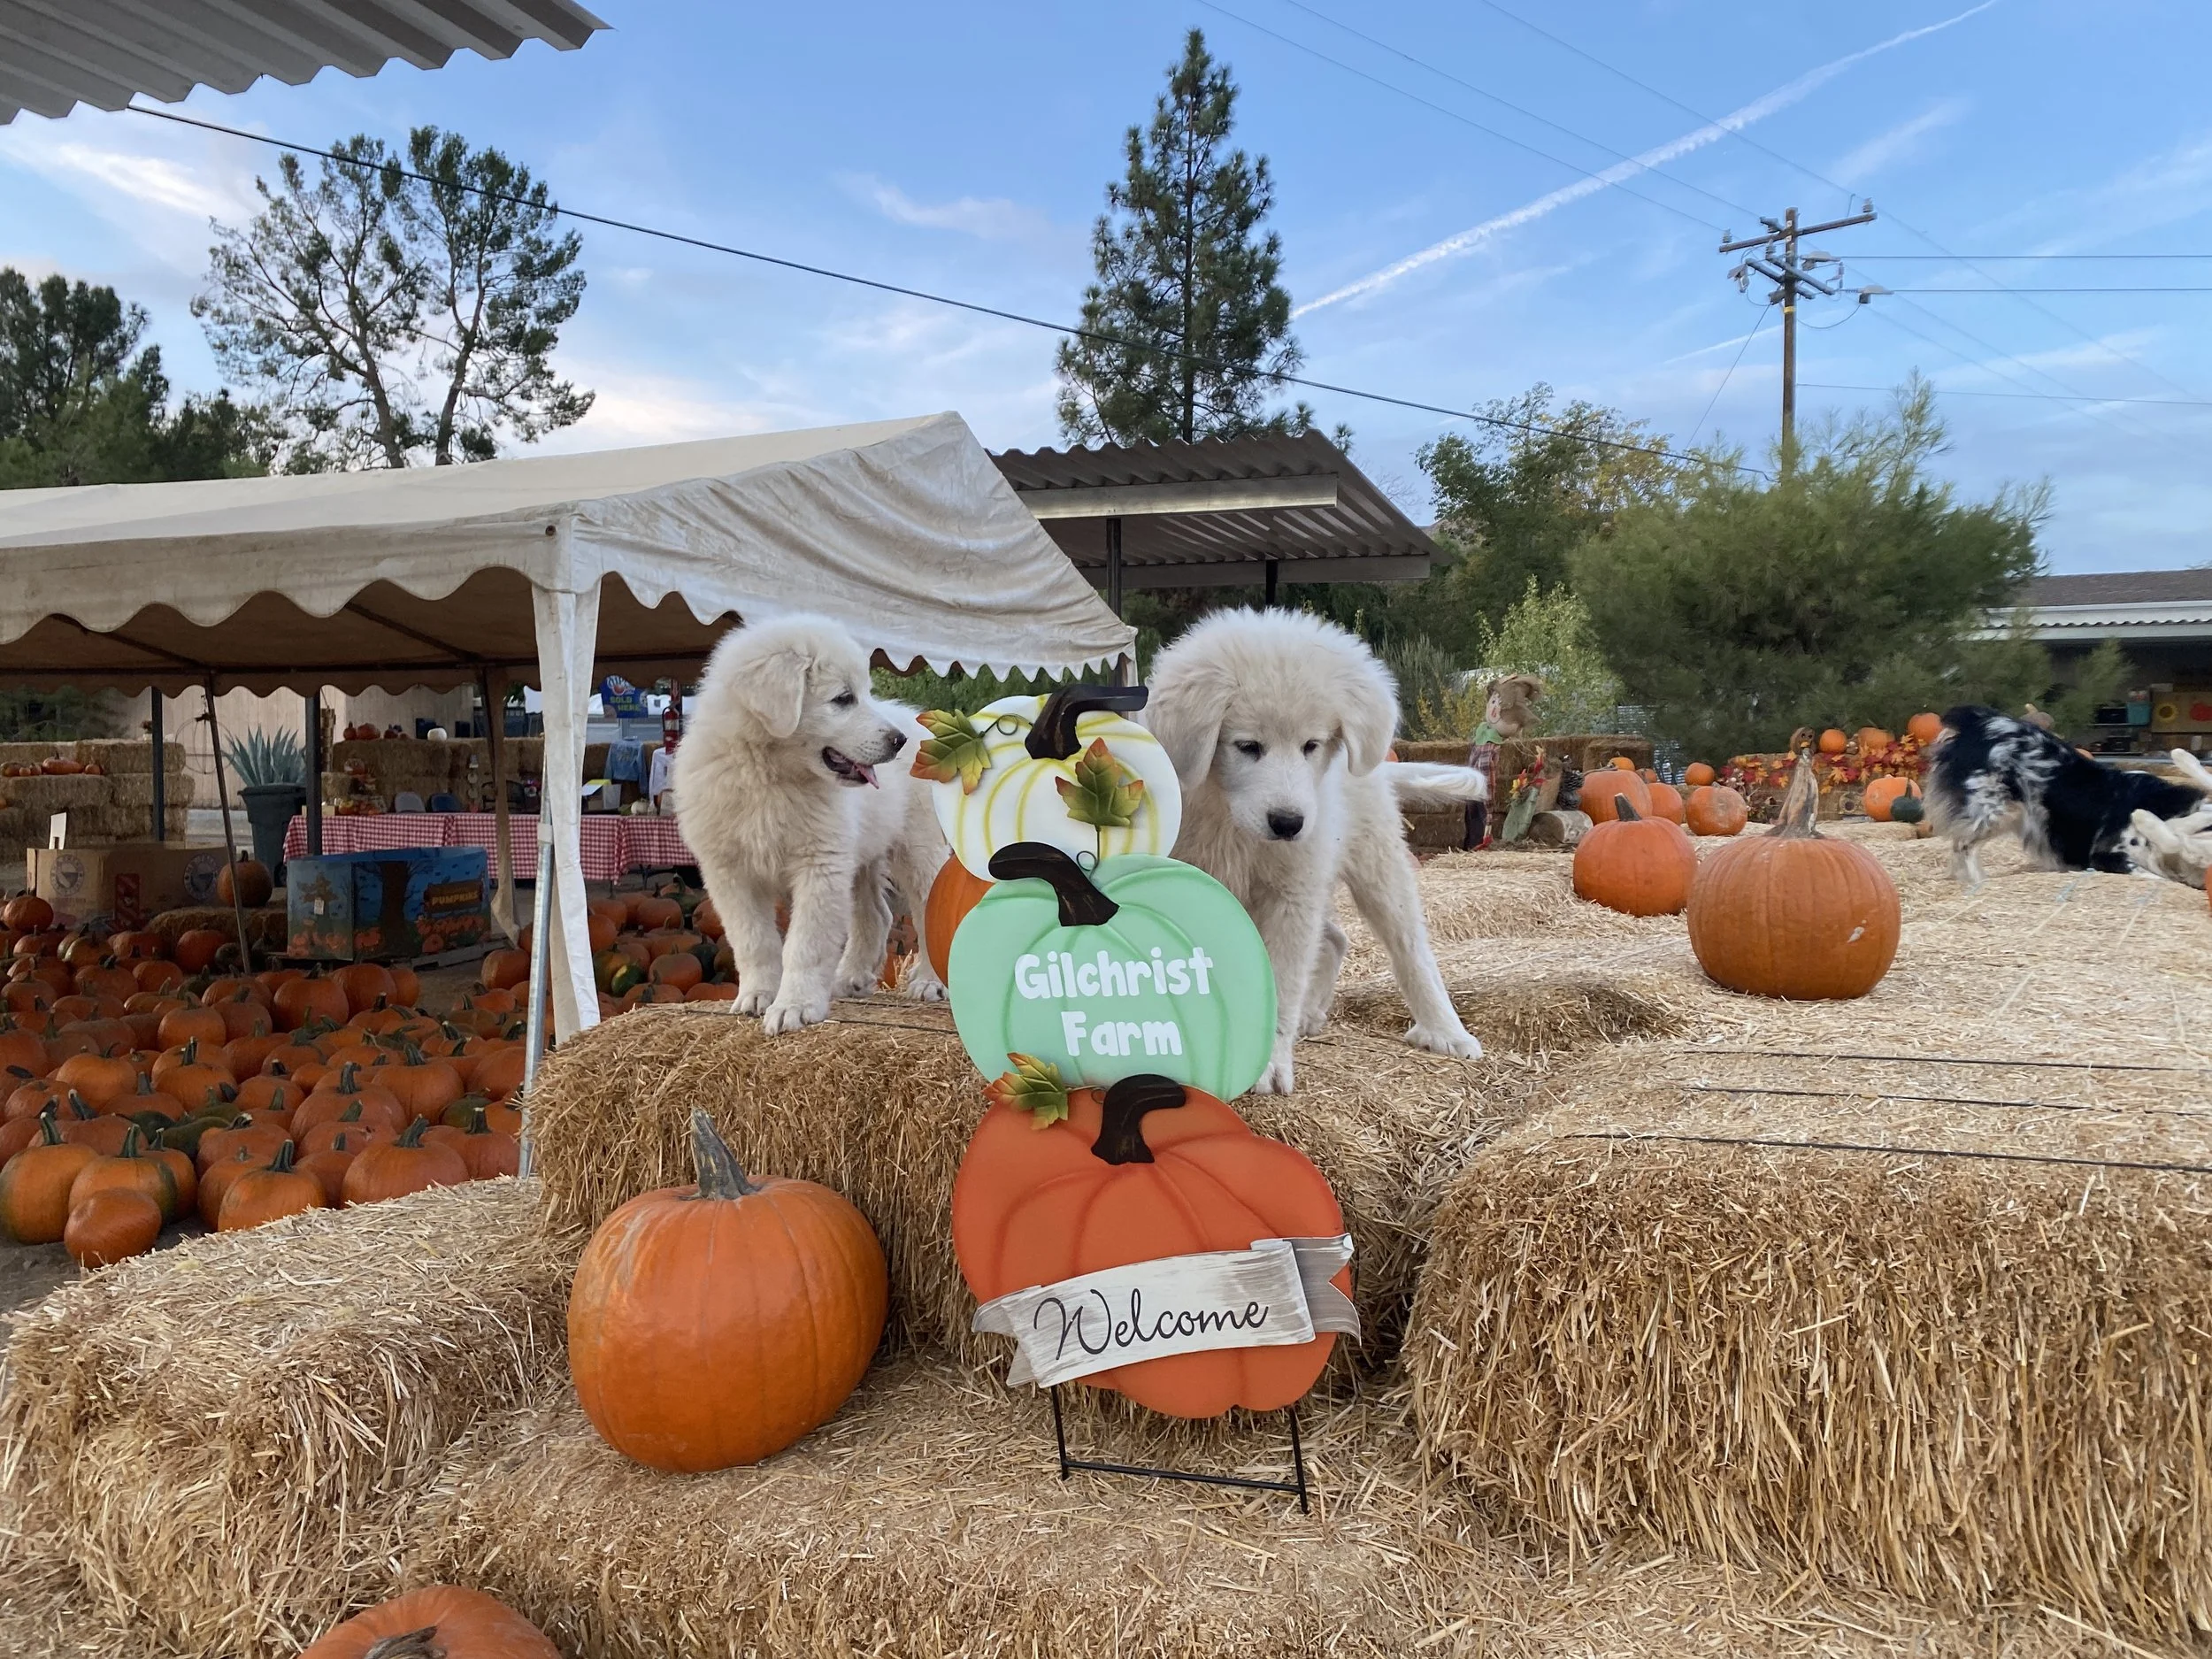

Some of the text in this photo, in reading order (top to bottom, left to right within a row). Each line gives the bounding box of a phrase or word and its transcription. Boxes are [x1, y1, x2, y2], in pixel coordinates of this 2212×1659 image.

[431, 891, 479, 905] PUMPKINS
[1015, 947, 1213, 999] Gilchrist
[1061, 1011, 1182, 1056] Farm
[1033, 1288, 1269, 1360] Welcome
